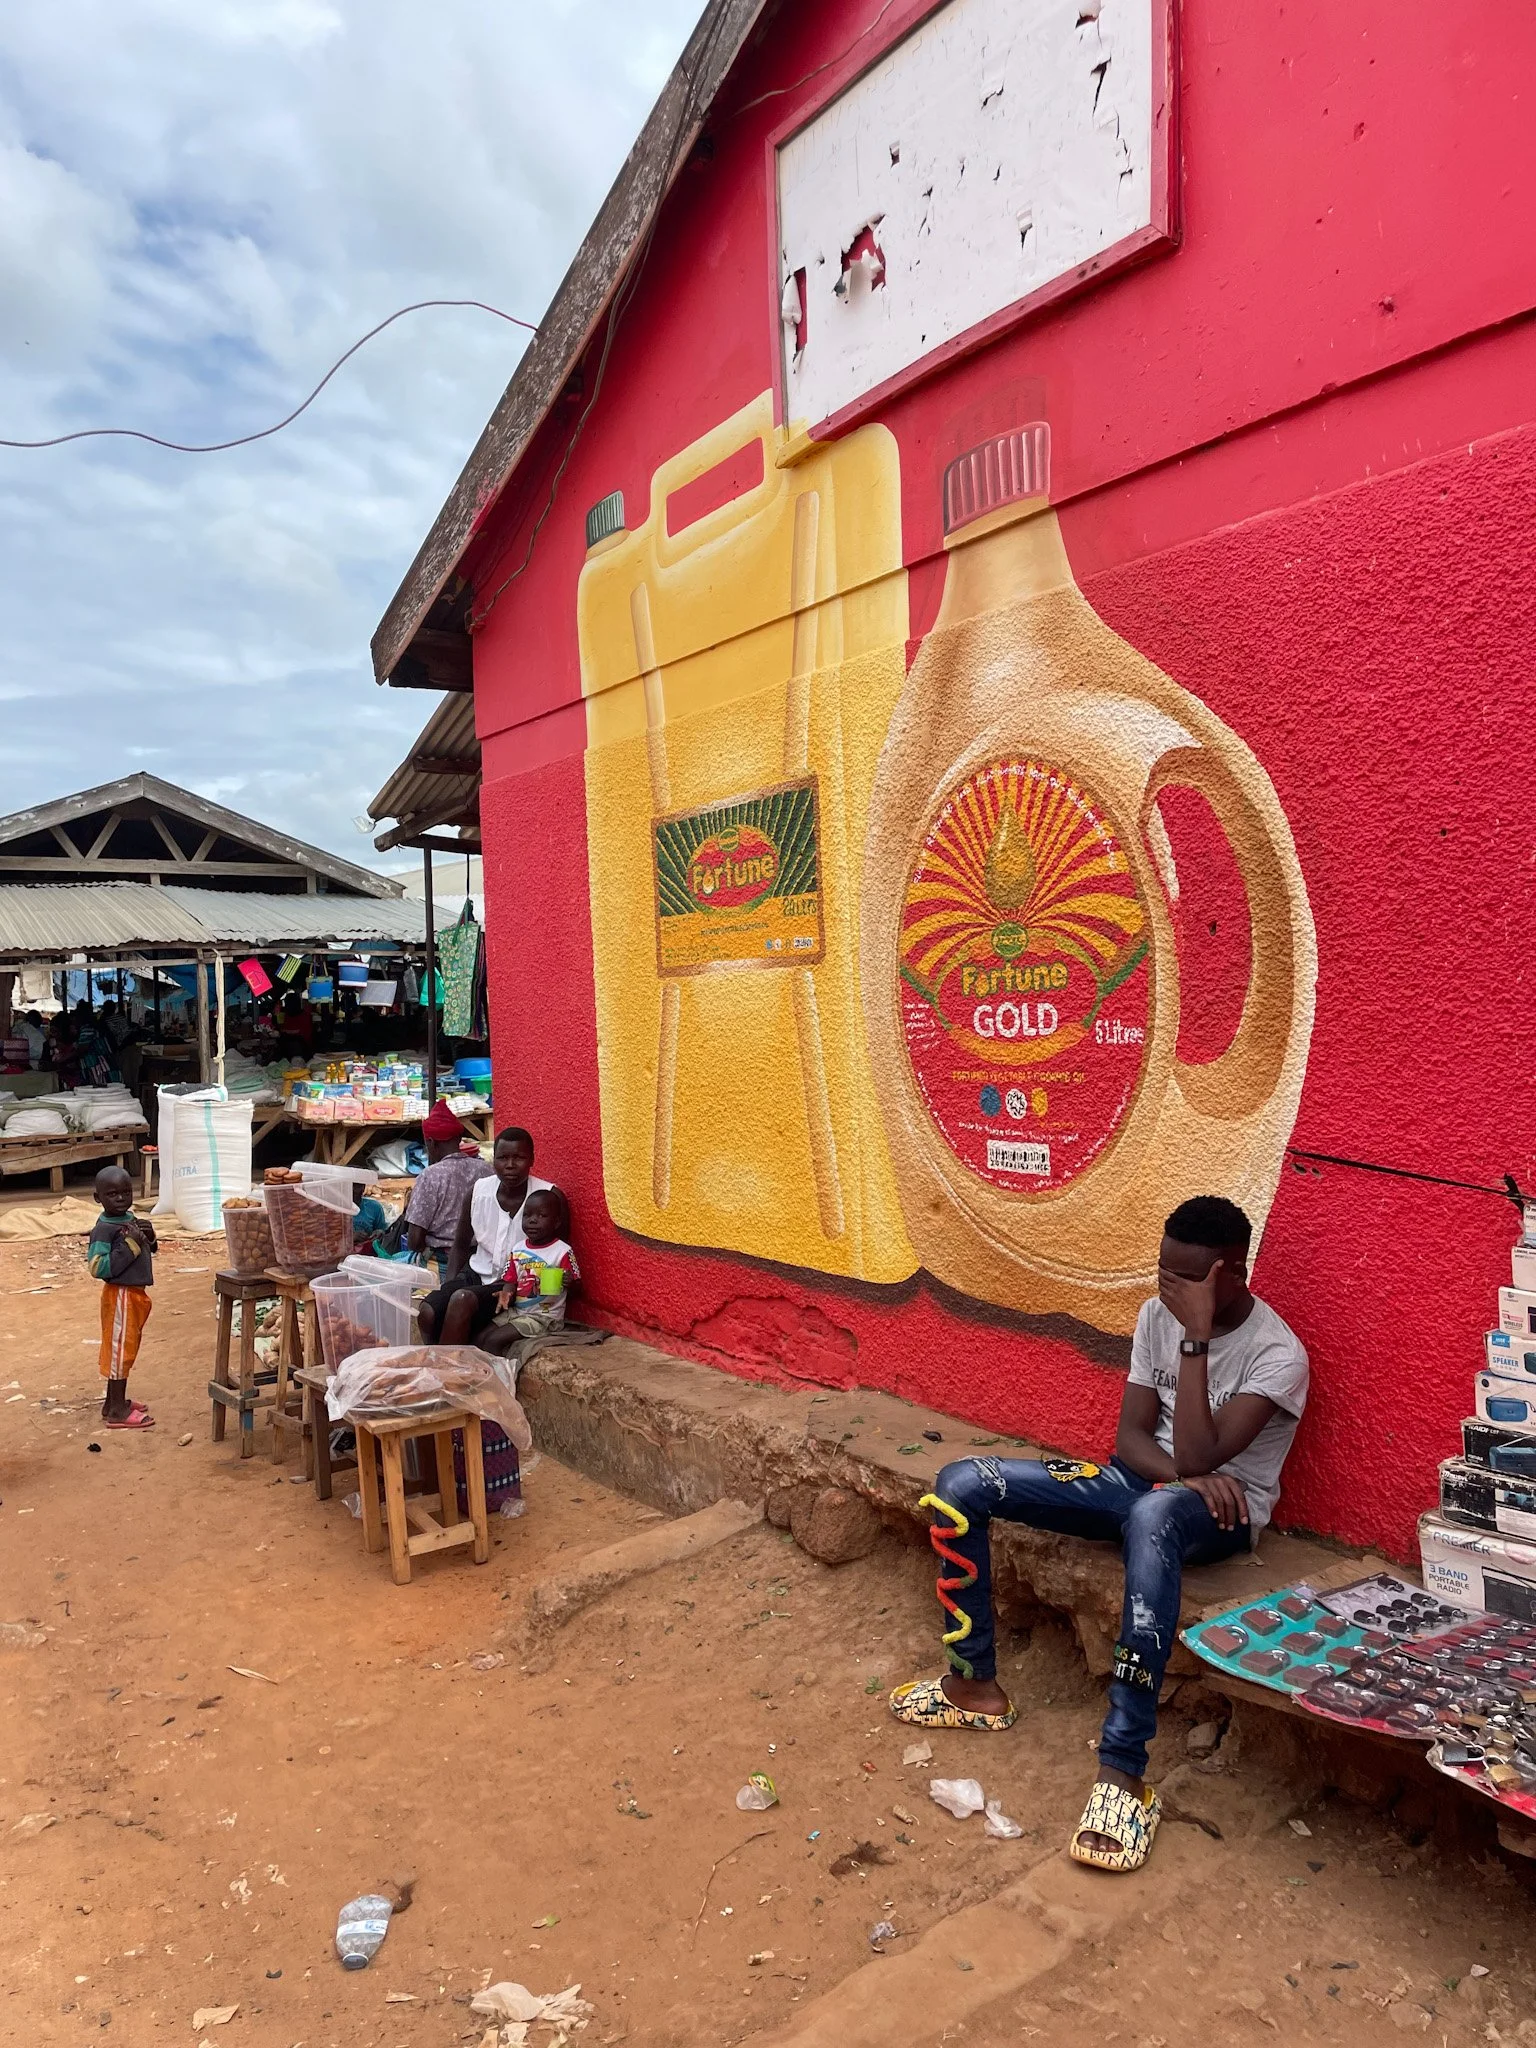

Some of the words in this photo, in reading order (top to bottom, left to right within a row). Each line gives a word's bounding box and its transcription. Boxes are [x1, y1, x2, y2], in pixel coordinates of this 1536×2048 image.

[692, 854, 776, 896] Fortune
[961, 960, 1069, 997] Fortune
[973, 1002, 1059, 1038] GOLD
[1492, 1356, 1519, 1367] SPEAKER
[1153, 1368, 1177, 1391] FEAR
[1428, 1573, 1470, 1591] PORTABLE
[1429, 1564, 1436, 1573] 3
[1438, 1567, 1468, 1581] BAND
[1436, 1583, 1462, 1595] RADIO
